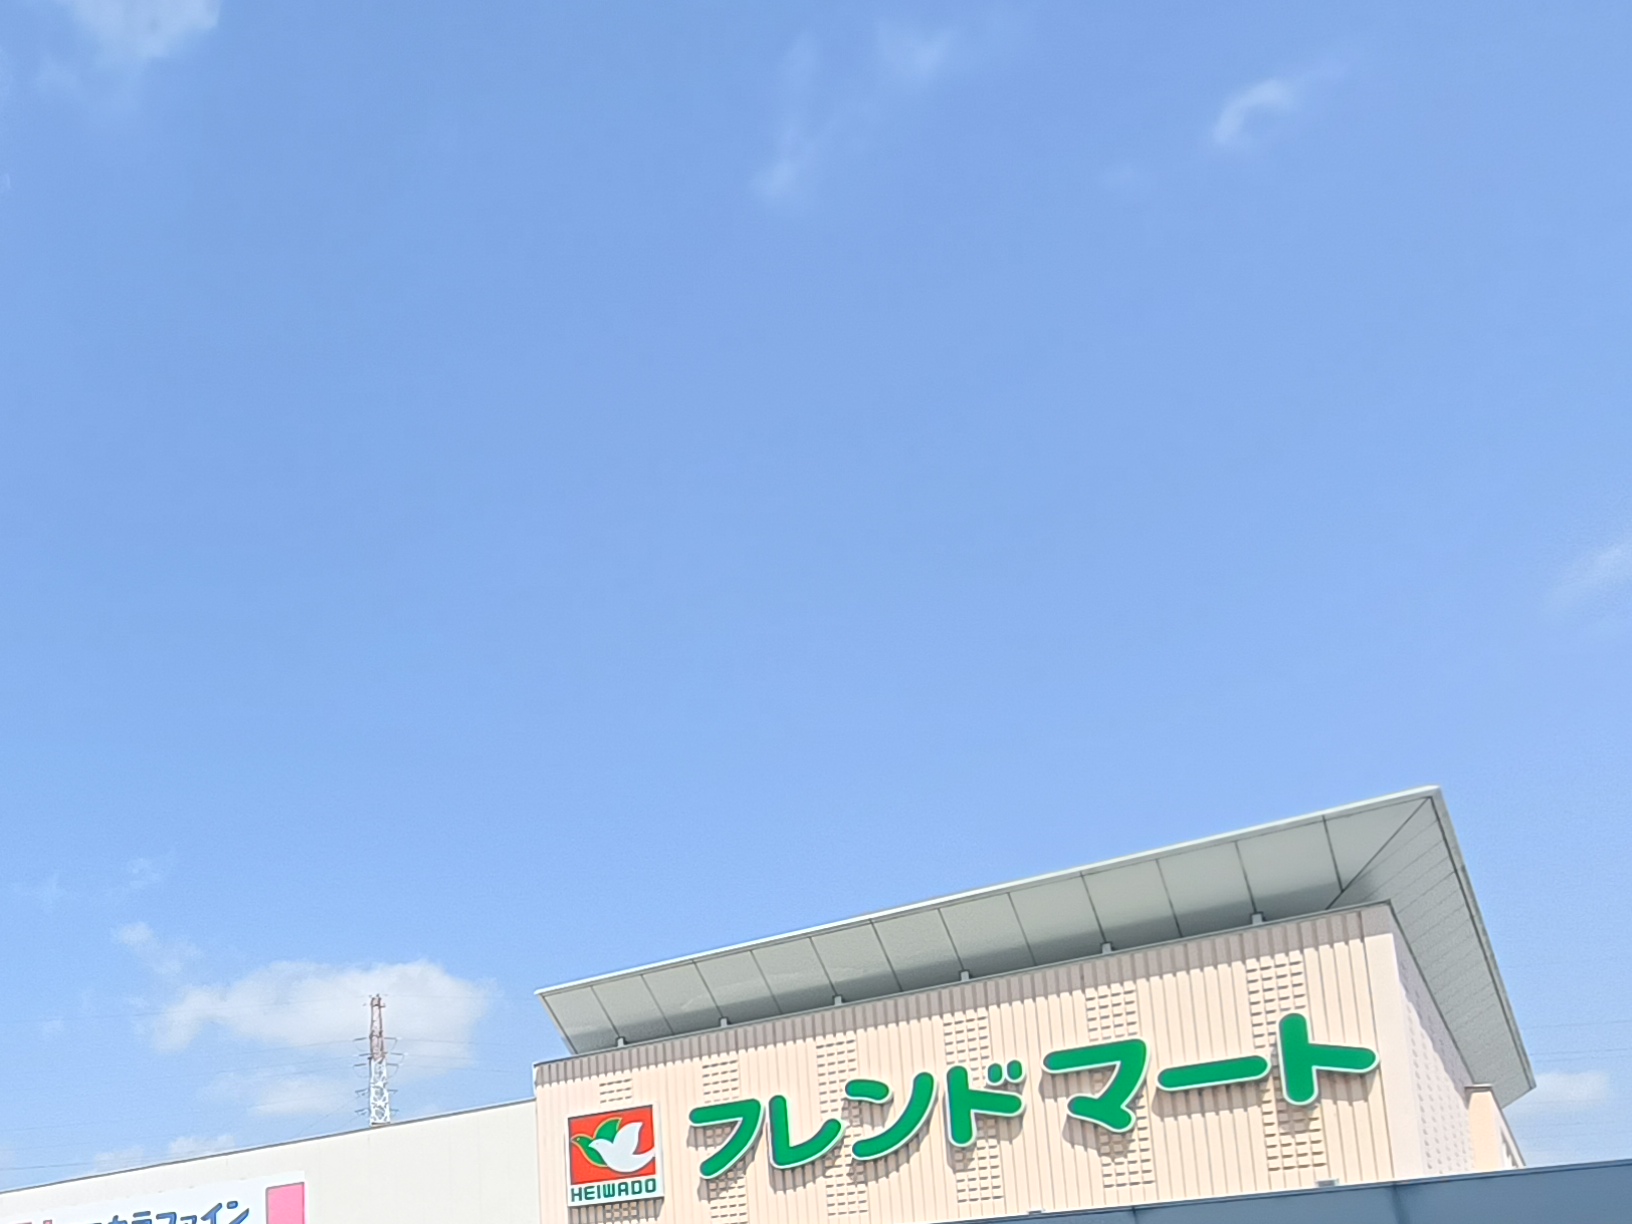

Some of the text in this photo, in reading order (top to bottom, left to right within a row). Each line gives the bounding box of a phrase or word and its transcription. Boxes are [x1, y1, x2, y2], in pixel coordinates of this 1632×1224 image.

[689, 1012, 1378, 1178] フレンドマート
[570, 1178, 656, 1202] HEIWADO
